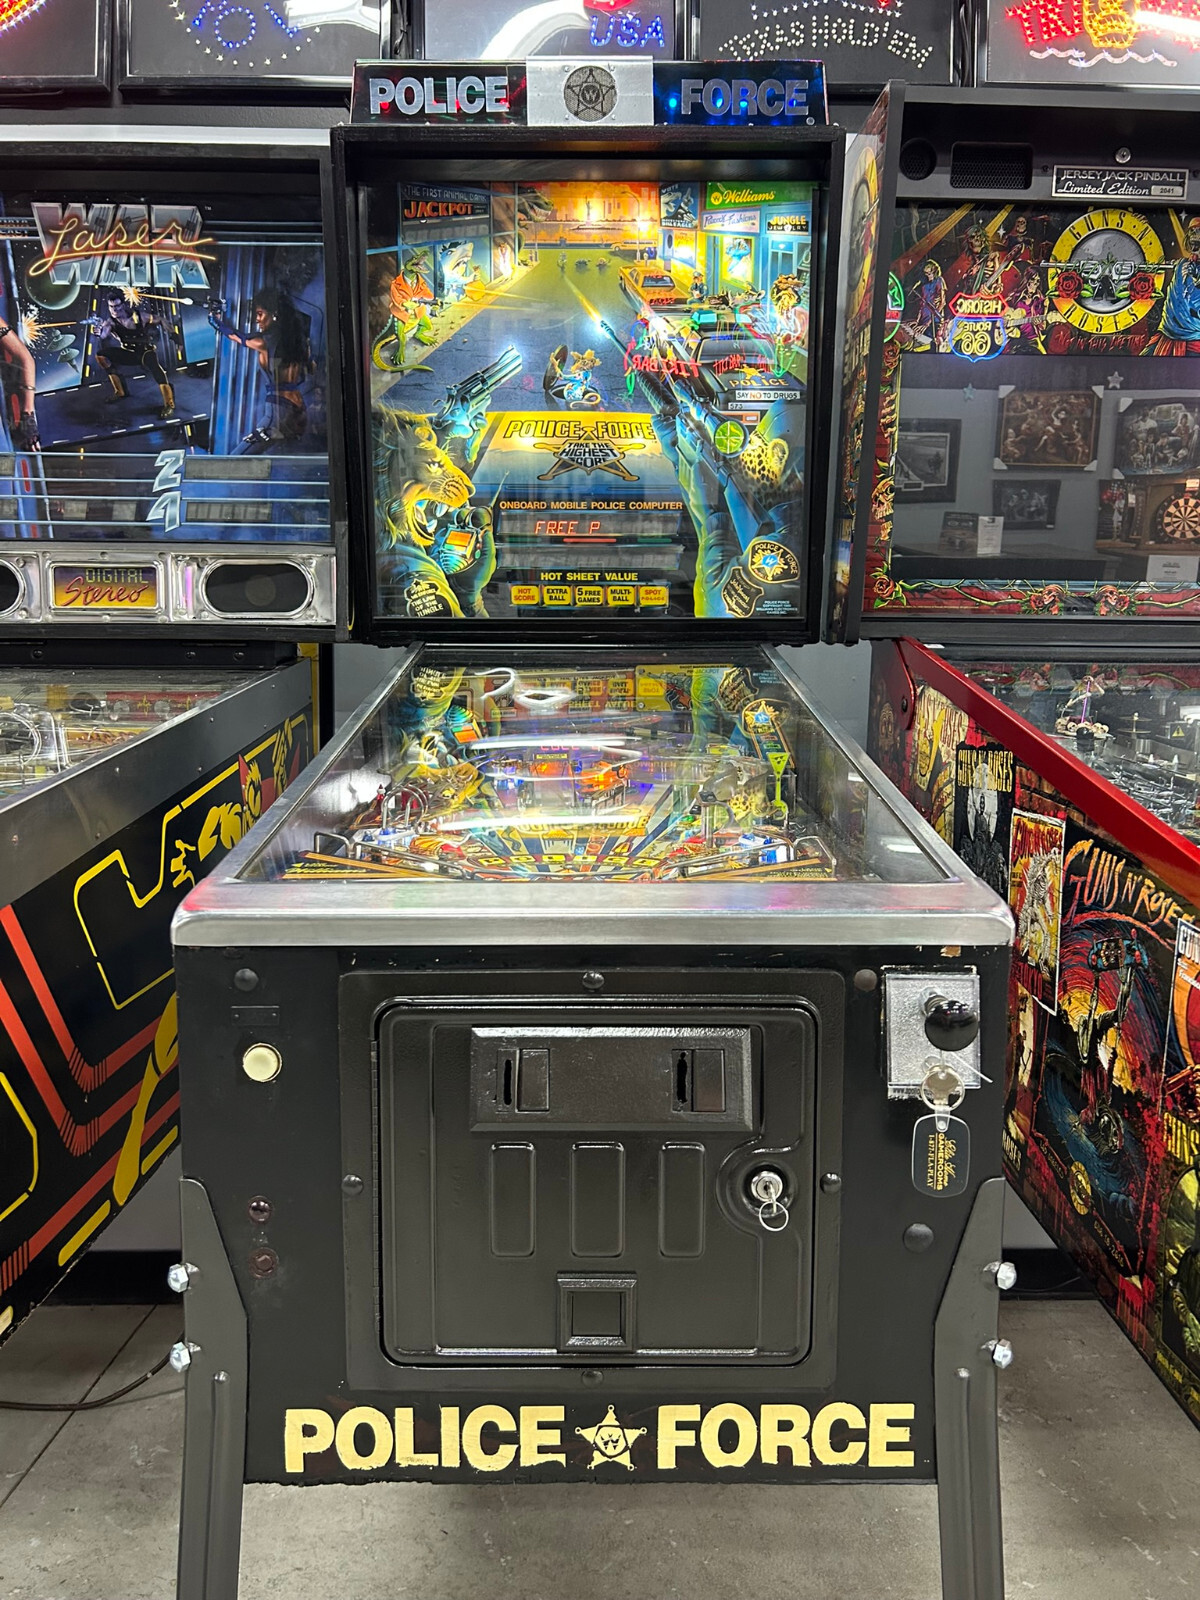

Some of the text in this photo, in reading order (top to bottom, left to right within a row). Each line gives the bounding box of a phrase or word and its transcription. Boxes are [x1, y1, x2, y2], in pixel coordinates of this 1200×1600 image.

[588, 14, 666, 48] USA
[717, 21, 805, 62] TEXAS
[369, 75, 510, 115] POLICE
[681, 78, 810, 116] FORCE
[1061, 169, 1184, 182] JERSEY JACK PINBALL
[422, 187, 442, 198] FIRST
[1057, 181, 1150, 195] Limited Edition
[723, 189, 774, 206] Williams
[404, 201, 473, 218] JACKPOT
[770, 215, 807, 226] JUNGLE
[1068, 212, 1127, 241] GUNS
[29, 217, 216, 276] Laser
[31, 202, 211, 289] WAR
[1063, 303, 1139, 333] ROSES
[729, 378, 790, 388] POLICE
[737, 391, 750, 399] SAY
[750, 391, 762, 399] NO
[773, 391, 798, 400] DRUGS
[503, 420, 657, 439] POLICE FORCE
[559, 448, 618, 458] HIGHEST
[152, 449, 185, 493] 2
[146, 491, 182, 533] 4
[499, 501, 683, 510] ONBOARD MOBILE POLICE COMPUTER
[535, 520, 601, 534] FREE P
[755, 543, 779, 552] POLICE
[784, 554, 798, 575] FORCE
[85, 568, 149, 584] DIGITAL
[540, 572, 639, 581] HOT SHEET VALUE
[62, 576, 149, 607] Stereo
[577, 587, 584, 596] 5
[577, 596, 601, 604] GAMES
[644, 588, 662, 596] SPOT
[416, 603, 444, 617] JUNGLE
[1060, 838, 1127, 926] GUNS
[1162, 1111, 1200, 1166] GUNS
[936, 1132, 946, 1191] GAMEROOMS
[283, 1404, 568, 1474] POLICE
[656, 1402, 916, 1470] FORCE
